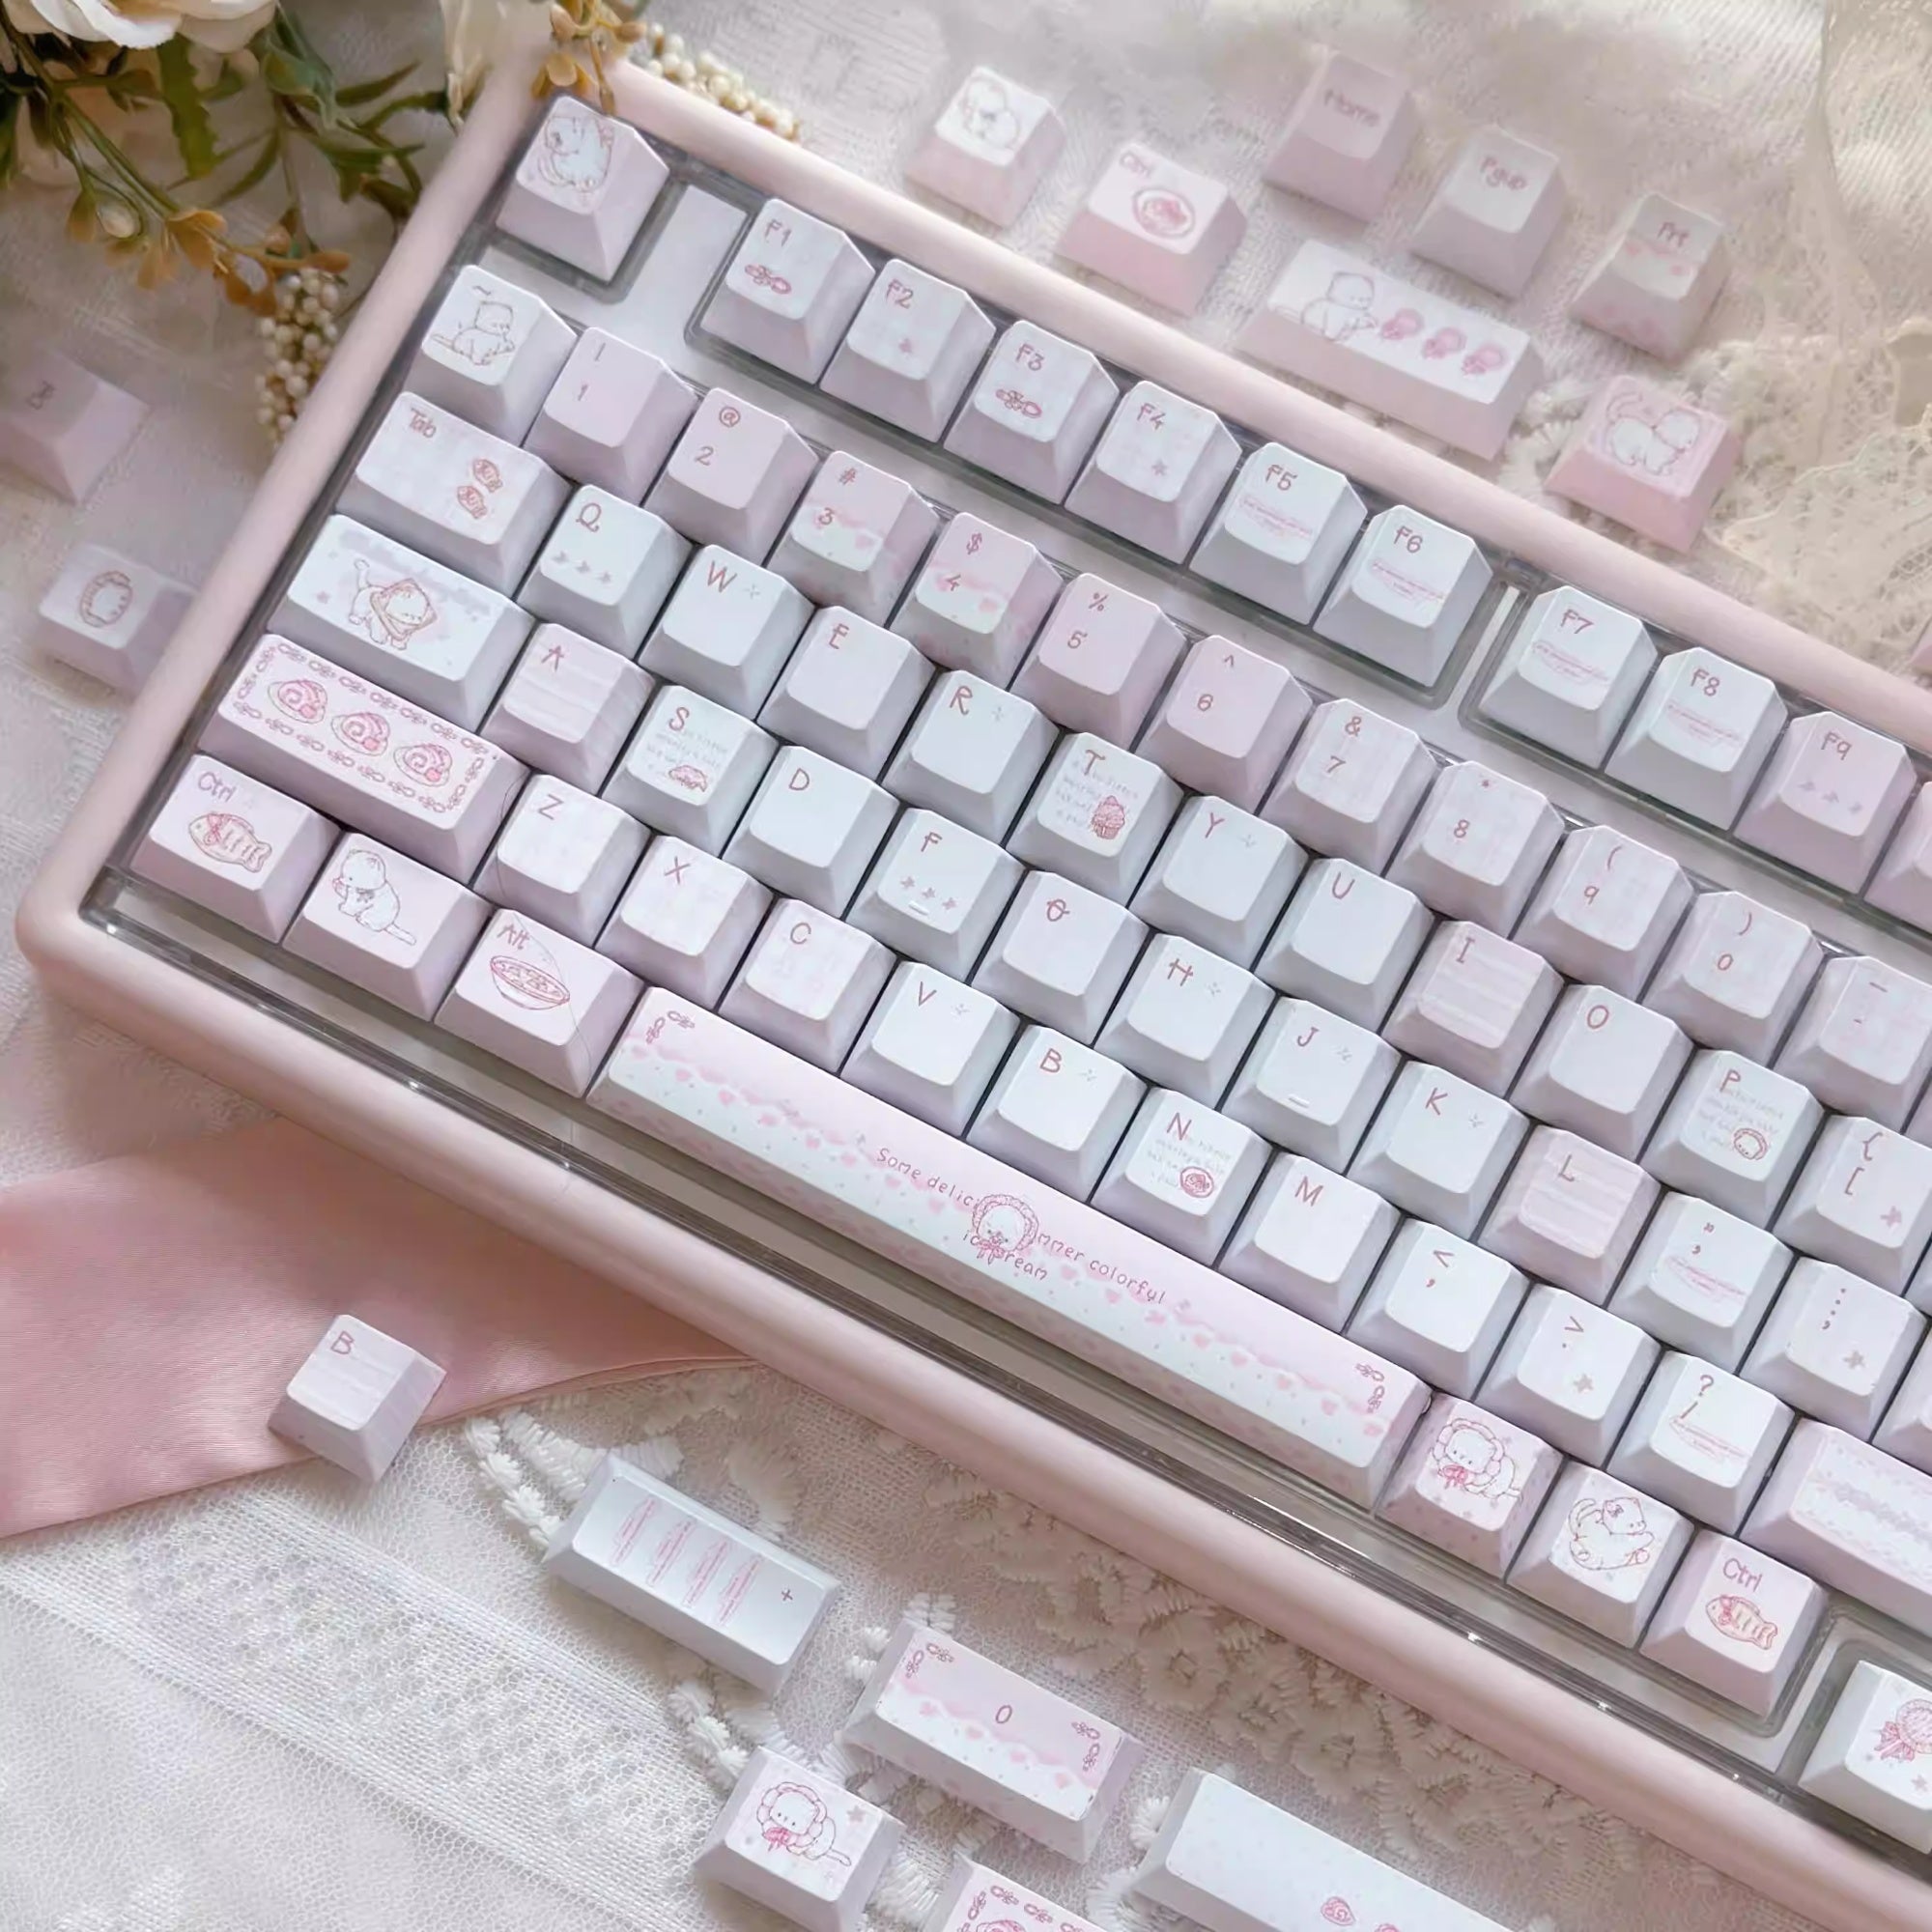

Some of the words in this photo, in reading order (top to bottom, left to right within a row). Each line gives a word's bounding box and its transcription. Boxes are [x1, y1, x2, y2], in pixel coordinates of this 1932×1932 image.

[764, 220, 787, 247] F1
[886, 279, 913, 309] F2
[1016, 343, 1044, 371] F3
[578, 384, 588, 401] 1
[410, 408, 437, 439] Tab
[719, 406, 741, 428] @
[1137, 403, 1165, 430] F4
[695, 446, 714, 466] 2
[839, 468, 857, 485] #
[1265, 465, 1297, 491] F5
[576, 502, 600, 532] Q
[818, 507, 835, 526] 3
[966, 533, 982, 554] $
[1394, 526, 1423, 553] F6
[708, 561, 737, 592] W
[944, 574, 961, 591] 4
[1089, 593, 1108, 611] %
[1560, 609, 1594, 634] F7
[829, 623, 849, 649] E
[1067, 631, 1088, 649] 5
[541, 645, 564, 670] A
[1690, 668, 1719, 696] F8
[950, 686, 974, 716] R
[1197, 694, 1213, 712] 6
[668, 707, 690, 731] S
[1345, 716, 1361, 736] &
[1821, 731, 1852, 760] F9
[1084, 750, 1105, 776] T
[1327, 755, 1346, 773] 7
[198, 772, 238, 803] Ctrl
[788, 768, 810, 790] D
[538, 794, 564, 821] Z
[1206, 812, 1225, 839] Y
[1454, 819, 1470, 838] 8
[921, 832, 942, 852] F
[665, 856, 690, 884] X
[1607, 846, 1622, 870] (
[1332, 872, 1356, 900] U
[1584, 886, 1600, 904] 9
[790, 923, 811, 945] C
[1739, 912, 1752, 936] )
[497, 923, 530, 951] Alt
[1167, 958, 1193, 986] H
[919, 981, 937, 1007] V
[1587, 1005, 1609, 1029] O
[1297, 1027, 1319, 1047] J
[1039, 1048, 1062, 1072] B
[1719, 1069, 1741, 1093] P
[1426, 1088, 1448, 1116] K
[1167, 1113, 1192, 1140] N
[1862, 1131, 1884, 1161] {
[1558, 1154, 1575, 1182] L
[1294, 1177, 1323, 1207] M
[1844, 1167, 1864, 1195] [
[877, 1148, 922, 1180] Some
[1090, 1259, 1166, 1304] colorful
[1434, 1250, 1454, 1267] <
[1564, 1316, 1583, 1332] >
[330, 1331, 355, 1355] B
[1698, 1375, 1714, 1397] ?
[1723, 1557, 1763, 1593] Ctrl
